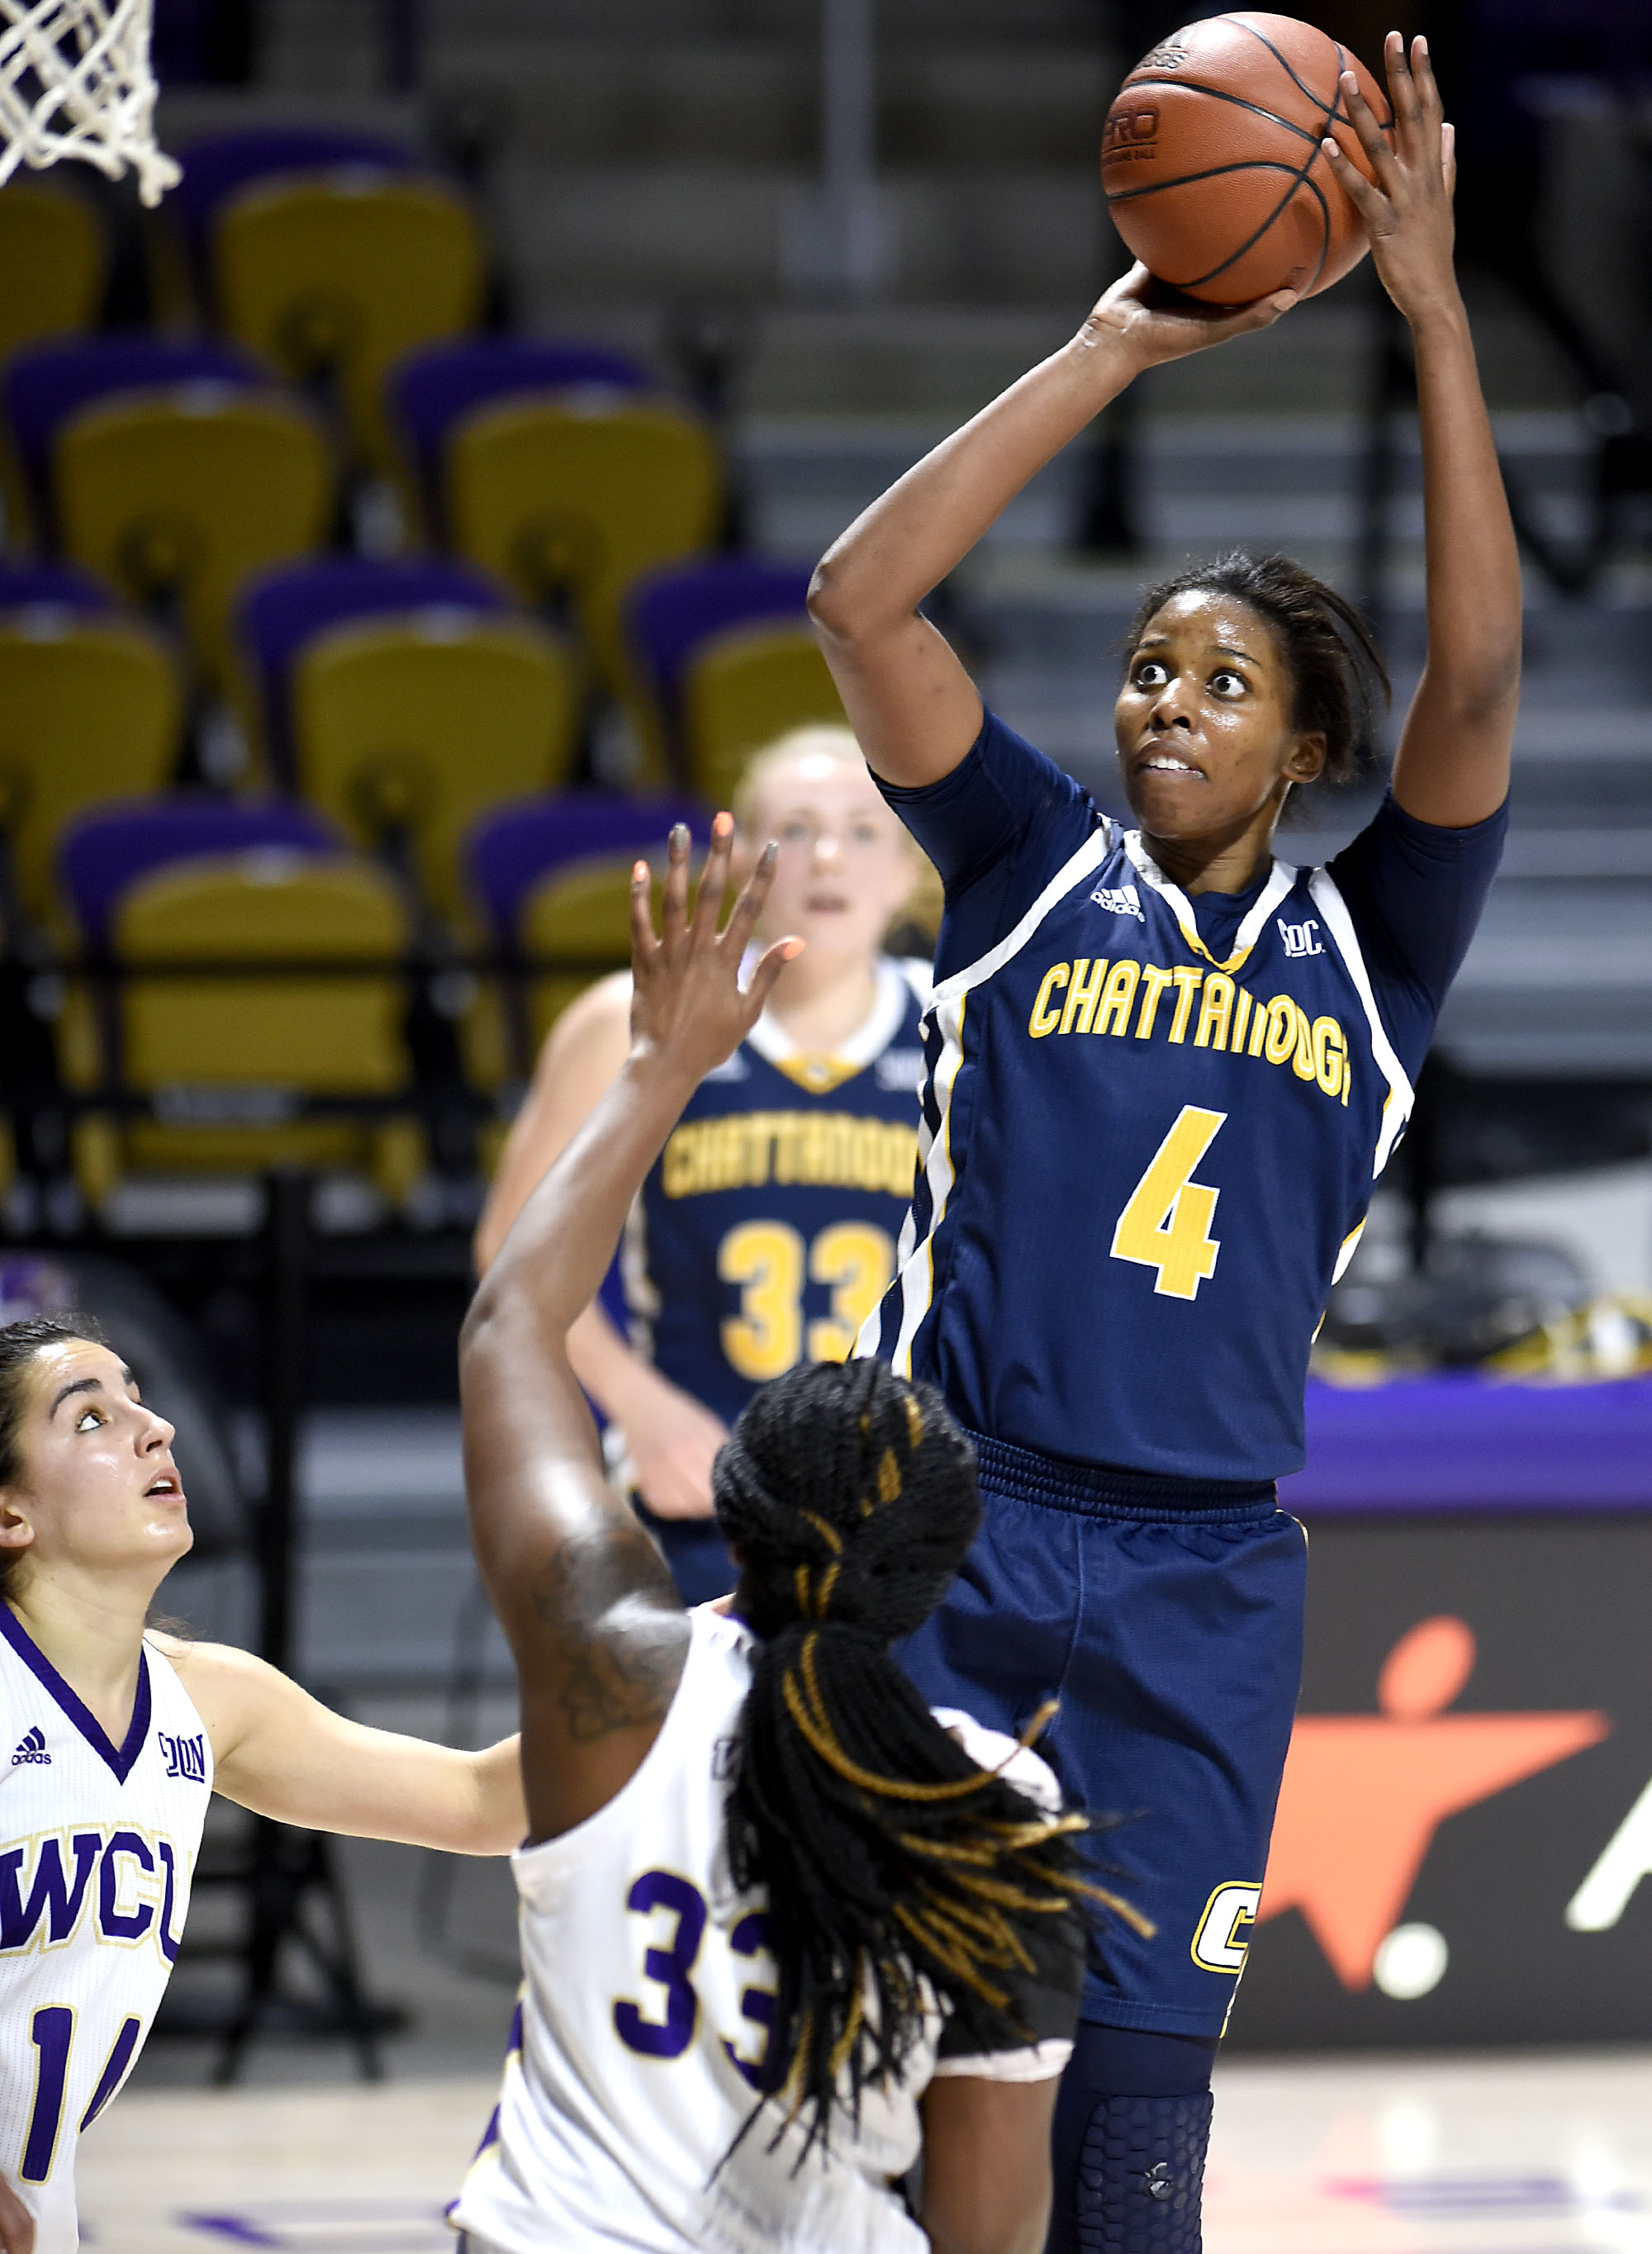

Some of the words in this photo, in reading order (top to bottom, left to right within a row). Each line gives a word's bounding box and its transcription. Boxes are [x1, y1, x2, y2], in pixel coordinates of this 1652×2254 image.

[1111, 1105, 1227, 1301] 4
[719, 1221, 895, 1381] 33
[12, 1752, 52, 1766] addas
[1190, 1880, 1263, 1975] C
